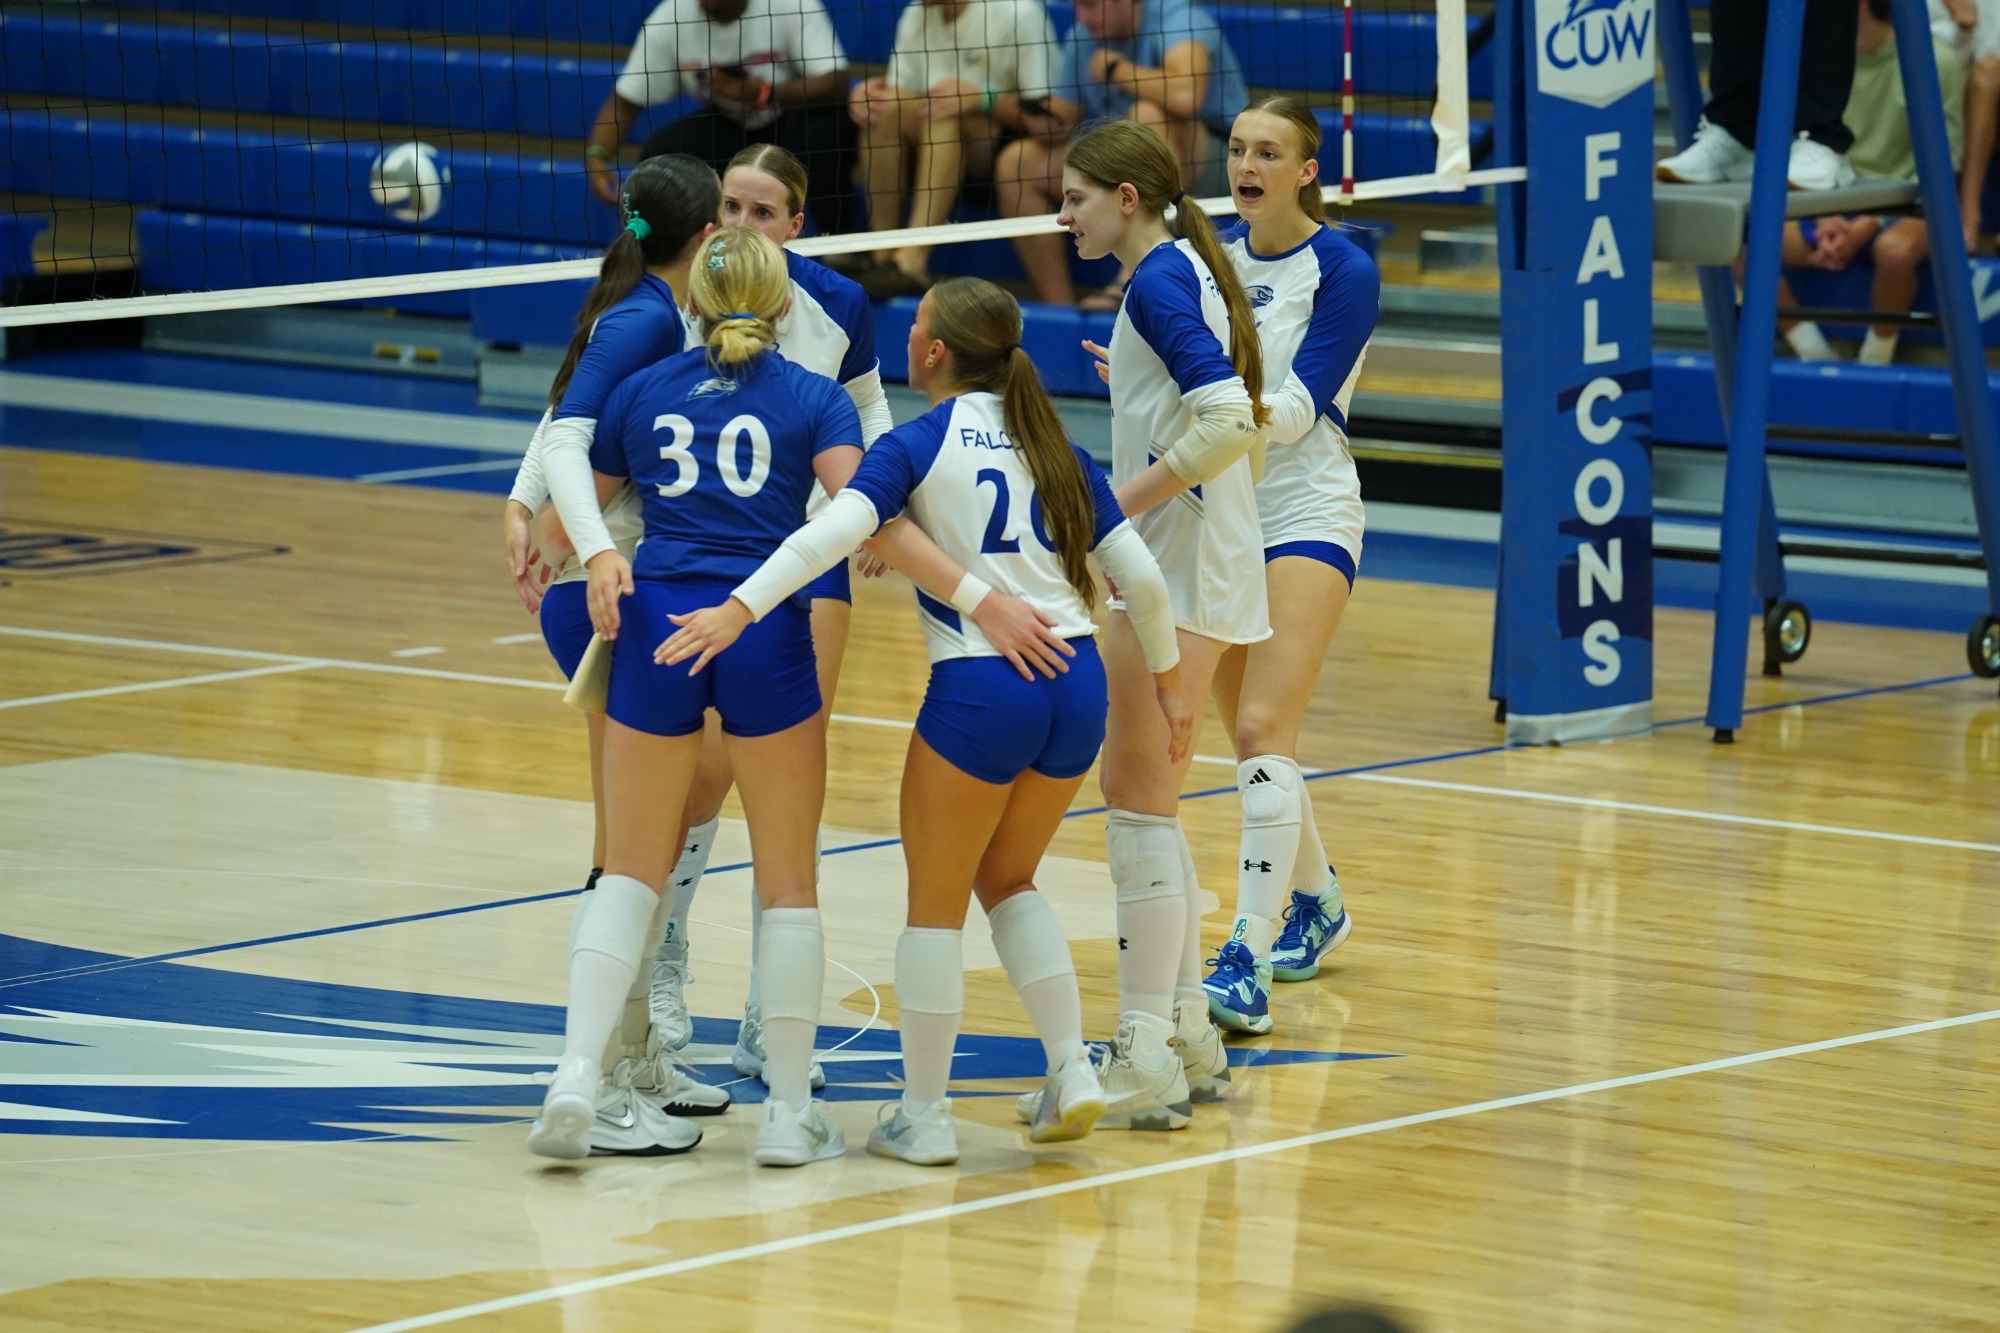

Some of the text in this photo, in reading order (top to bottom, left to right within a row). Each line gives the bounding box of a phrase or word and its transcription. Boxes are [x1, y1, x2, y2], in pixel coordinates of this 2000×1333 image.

[1545, 9, 1651, 70] CUW
[960, 428, 1023, 450] FALC
[1574, 131, 1625, 687] FALCONS
[652, 413, 772, 498] 30
